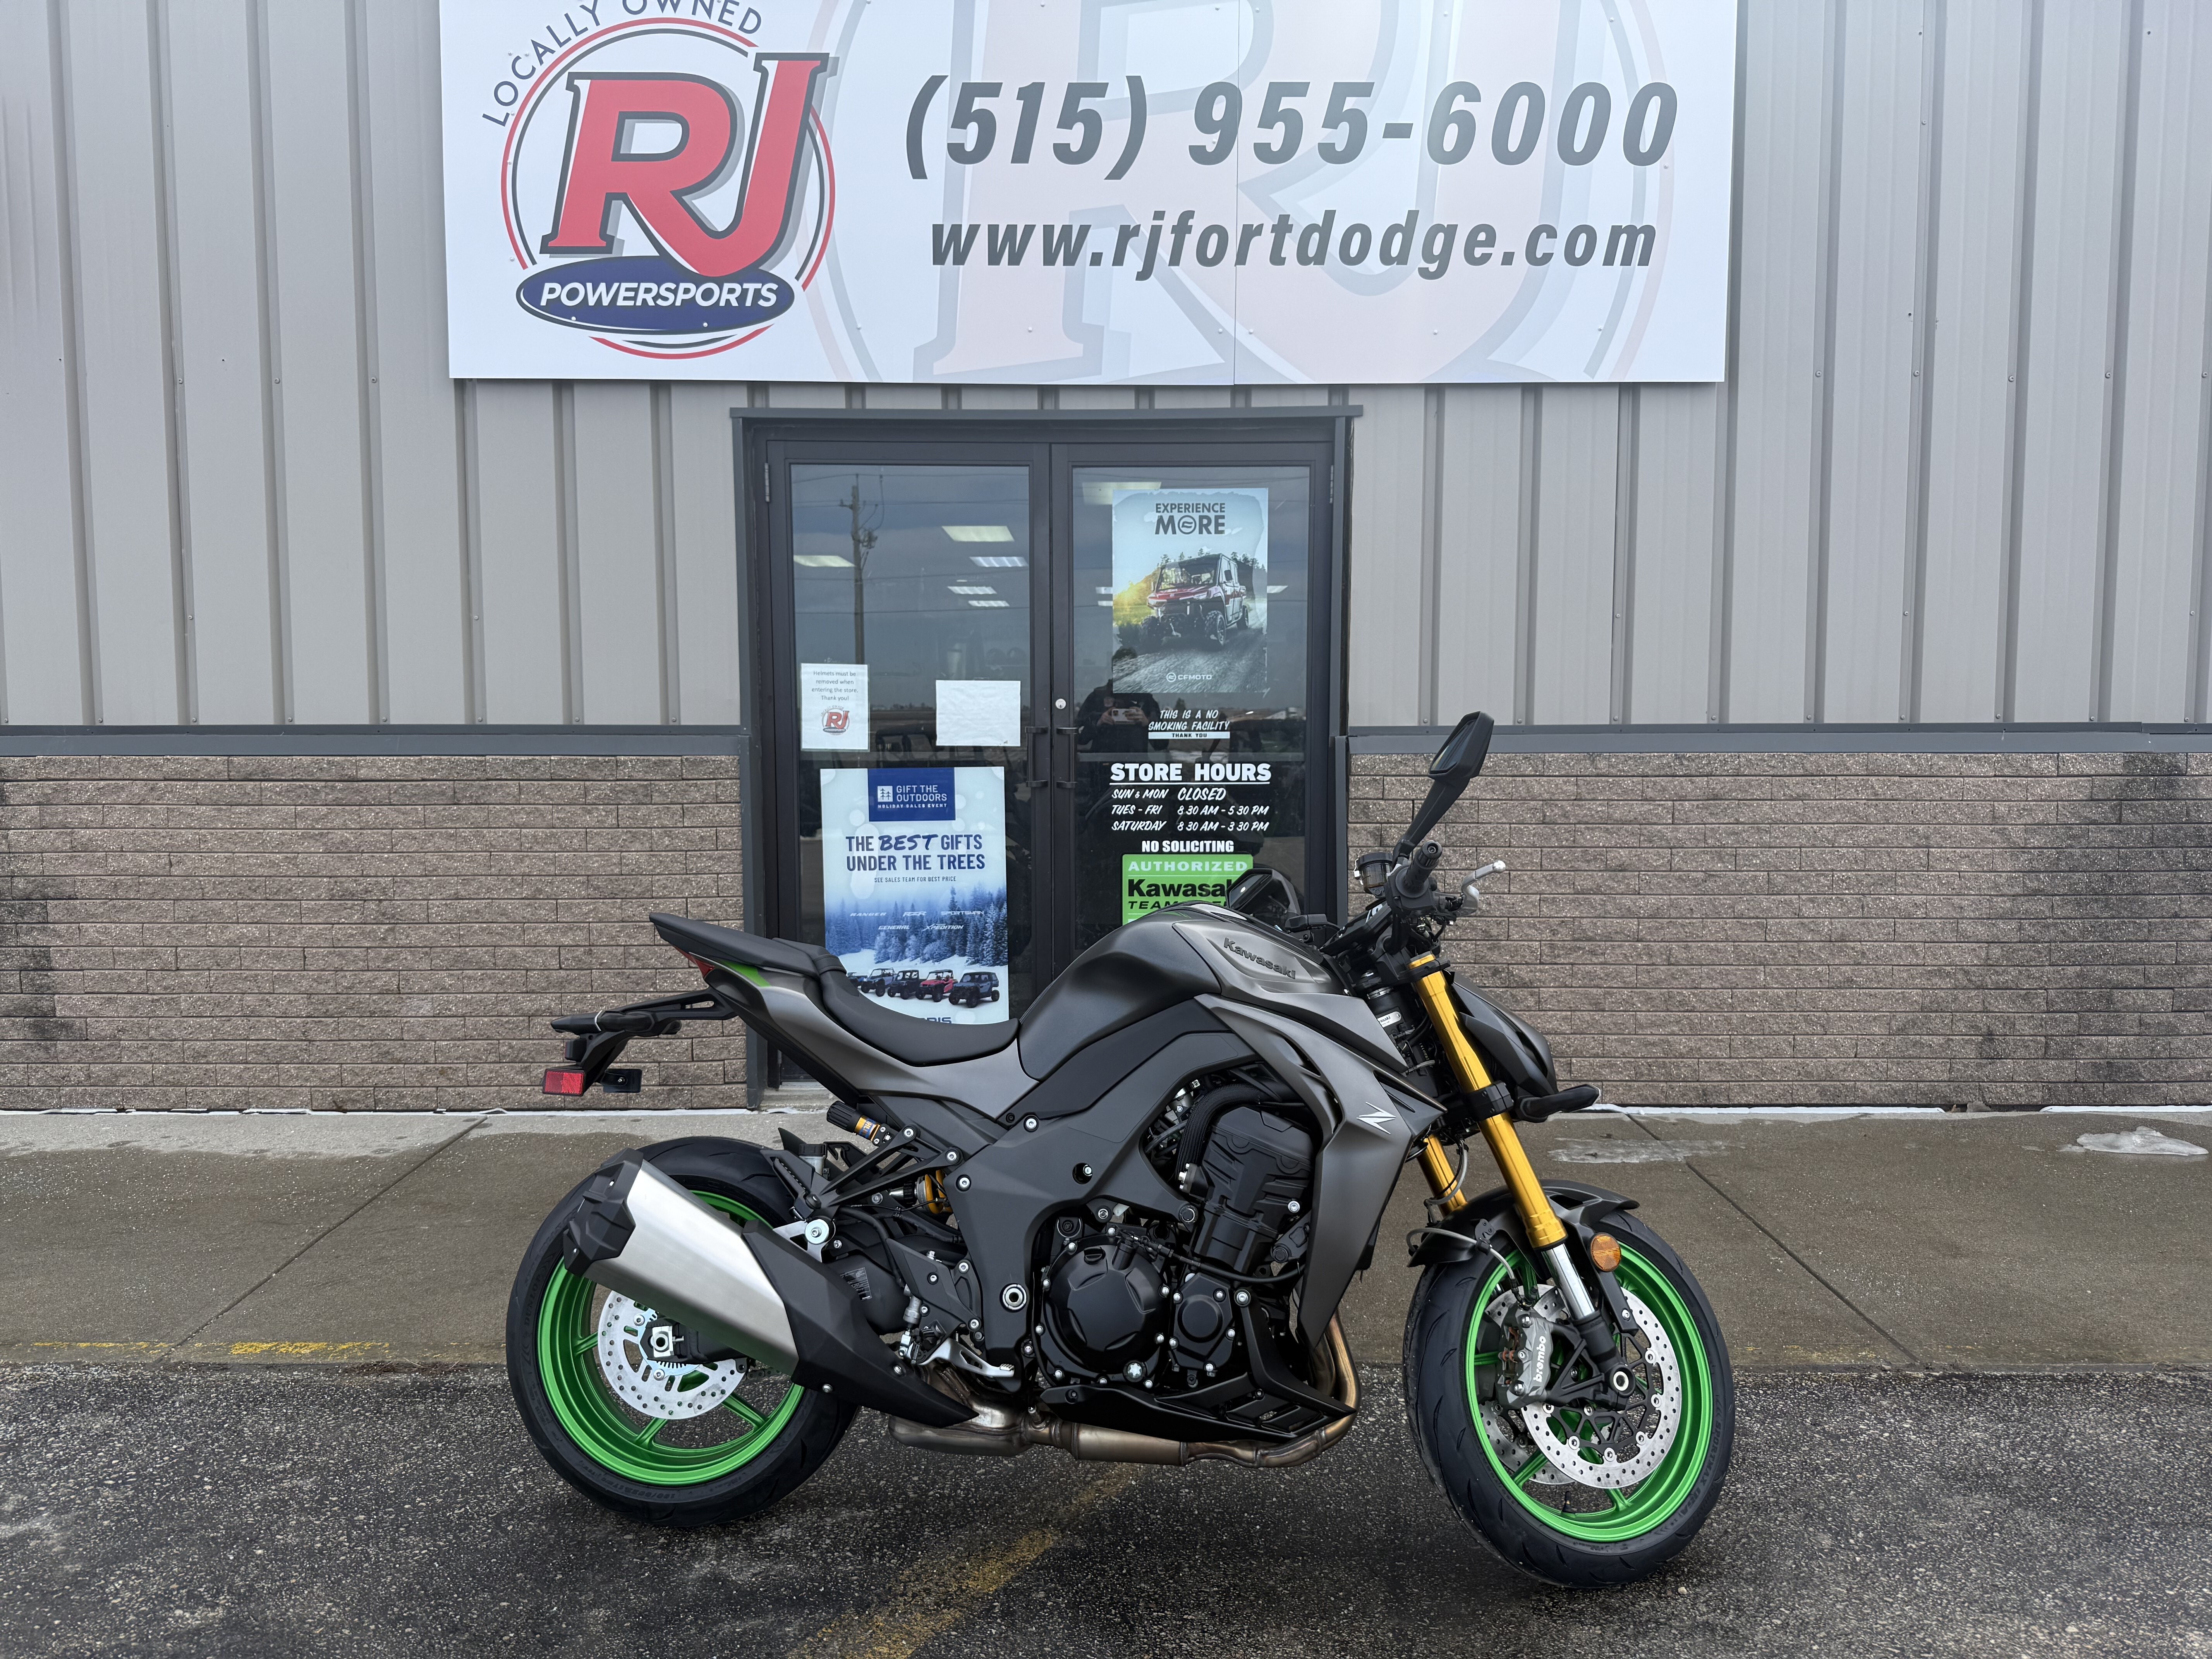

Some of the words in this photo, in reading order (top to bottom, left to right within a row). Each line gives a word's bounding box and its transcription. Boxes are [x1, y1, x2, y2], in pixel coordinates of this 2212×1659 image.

[482, 0, 601, 127] LOCALLY
[623, 0, 761, 34] OWNED
[906, 75, 1147, 180] (515)
[1188, 81, 1677, 167] 955-6000
[539, 53, 830, 277] RJ
[931, 209, 1657, 281] www.rjfortdodge.com
[541, 282, 778, 307] POWERSPORTS
[1156, 503, 1225, 513] EXPERIENCE
[825, 711, 850, 729] RJ
[1160, 710, 1178, 719] THIS
[1182, 710, 1191, 719] IS
[1195, 710, 1201, 719] A
[1206, 710, 1219, 719] NO
[1148, 721, 1187, 730] SMOKING
[1191, 721, 1230, 730] FACILITY
[1110, 763, 1182, 781] STORE
[1195, 763, 1271, 781] HOURS
[896, 793, 947, 802] OUTDOORS
[1111, 789, 1135, 799] SUN
[1142, 788, 1169, 799] MON
[1177, 787, 1226, 800] CLOSED
[1111, 805, 1136, 814] TUES
[1144, 805, 1163, 814] FRI
[1200, 805, 1219, 815] AM
[1251, 805, 1269, 815] PM
[1111, 821, 1167, 831] SATURDAY
[1200, 821, 1219, 831] AM
[1251, 821, 1269, 831] PM
[846, 836, 874, 852] THE
[878, 834, 938, 851] BEST
[941, 834, 982, 850] GIFTS
[1142, 841, 1159, 852] NO
[1162, 840, 1234, 852] SOLICITING
[847, 855, 897, 871] UNDER
[902, 855, 932, 870] THE
[937, 854, 985, 870] TREES
[1128, 861, 1247, 871] AUTHORIZED
[1223, 937, 1296, 980] Kawasaki
[1533, 1336, 1546, 1382] brembo
